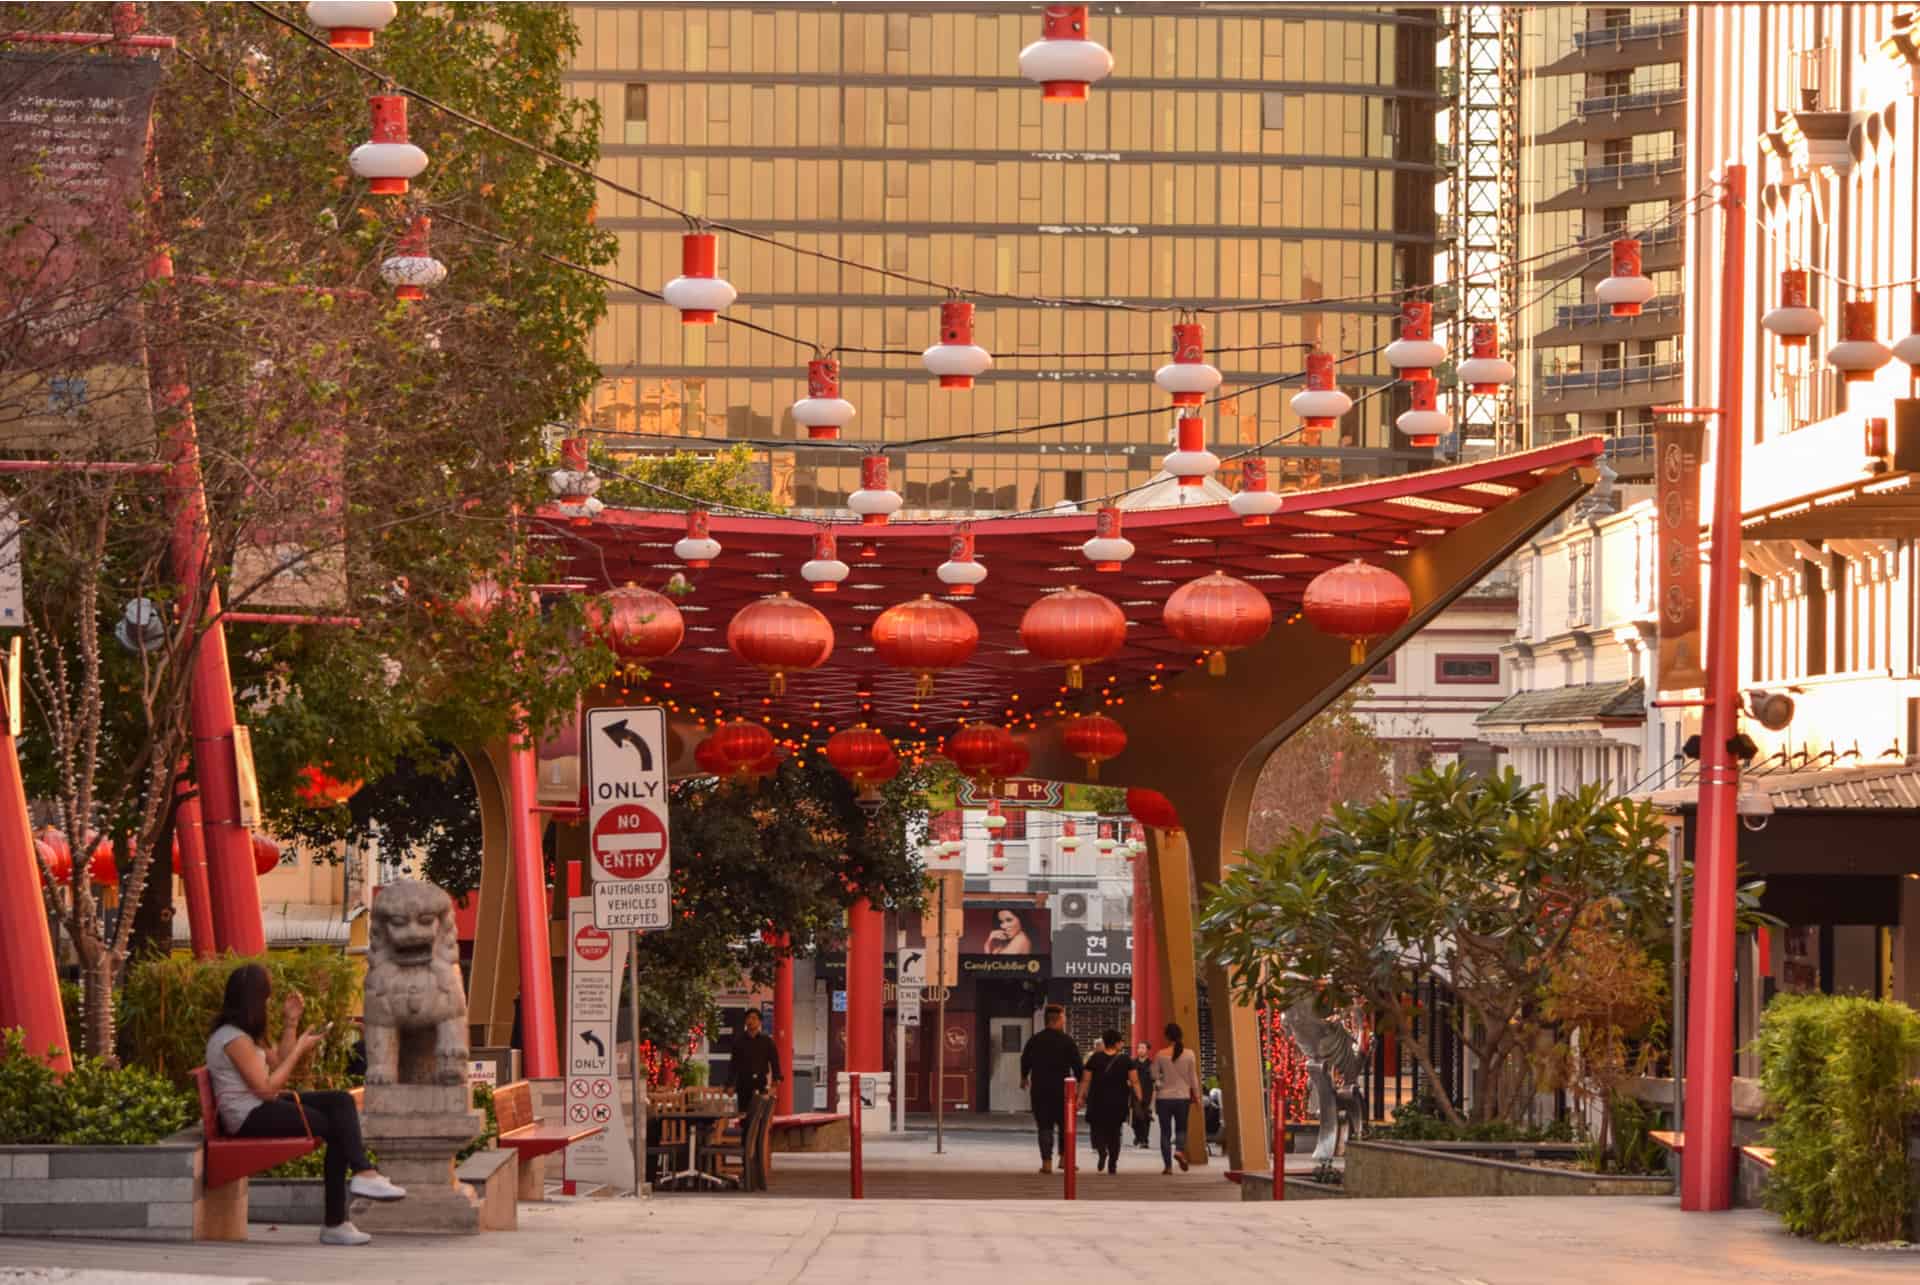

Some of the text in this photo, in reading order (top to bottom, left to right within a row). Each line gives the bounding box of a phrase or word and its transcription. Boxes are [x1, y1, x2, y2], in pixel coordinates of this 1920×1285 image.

[599, 781, 658, 799] ONLY
[618, 814, 641, 829] NO
[603, 853, 656, 868] ENTRY
[600, 883, 664, 895] AUTHORISED
[608, 899, 656, 910] VEHICLES
[608, 913, 657, 925] EXCEPTED
[1065, 962, 1133, 975] HYUNDA
[900, 976, 924, 984] ONLY
[575, 1059, 606, 1069] ONLY
